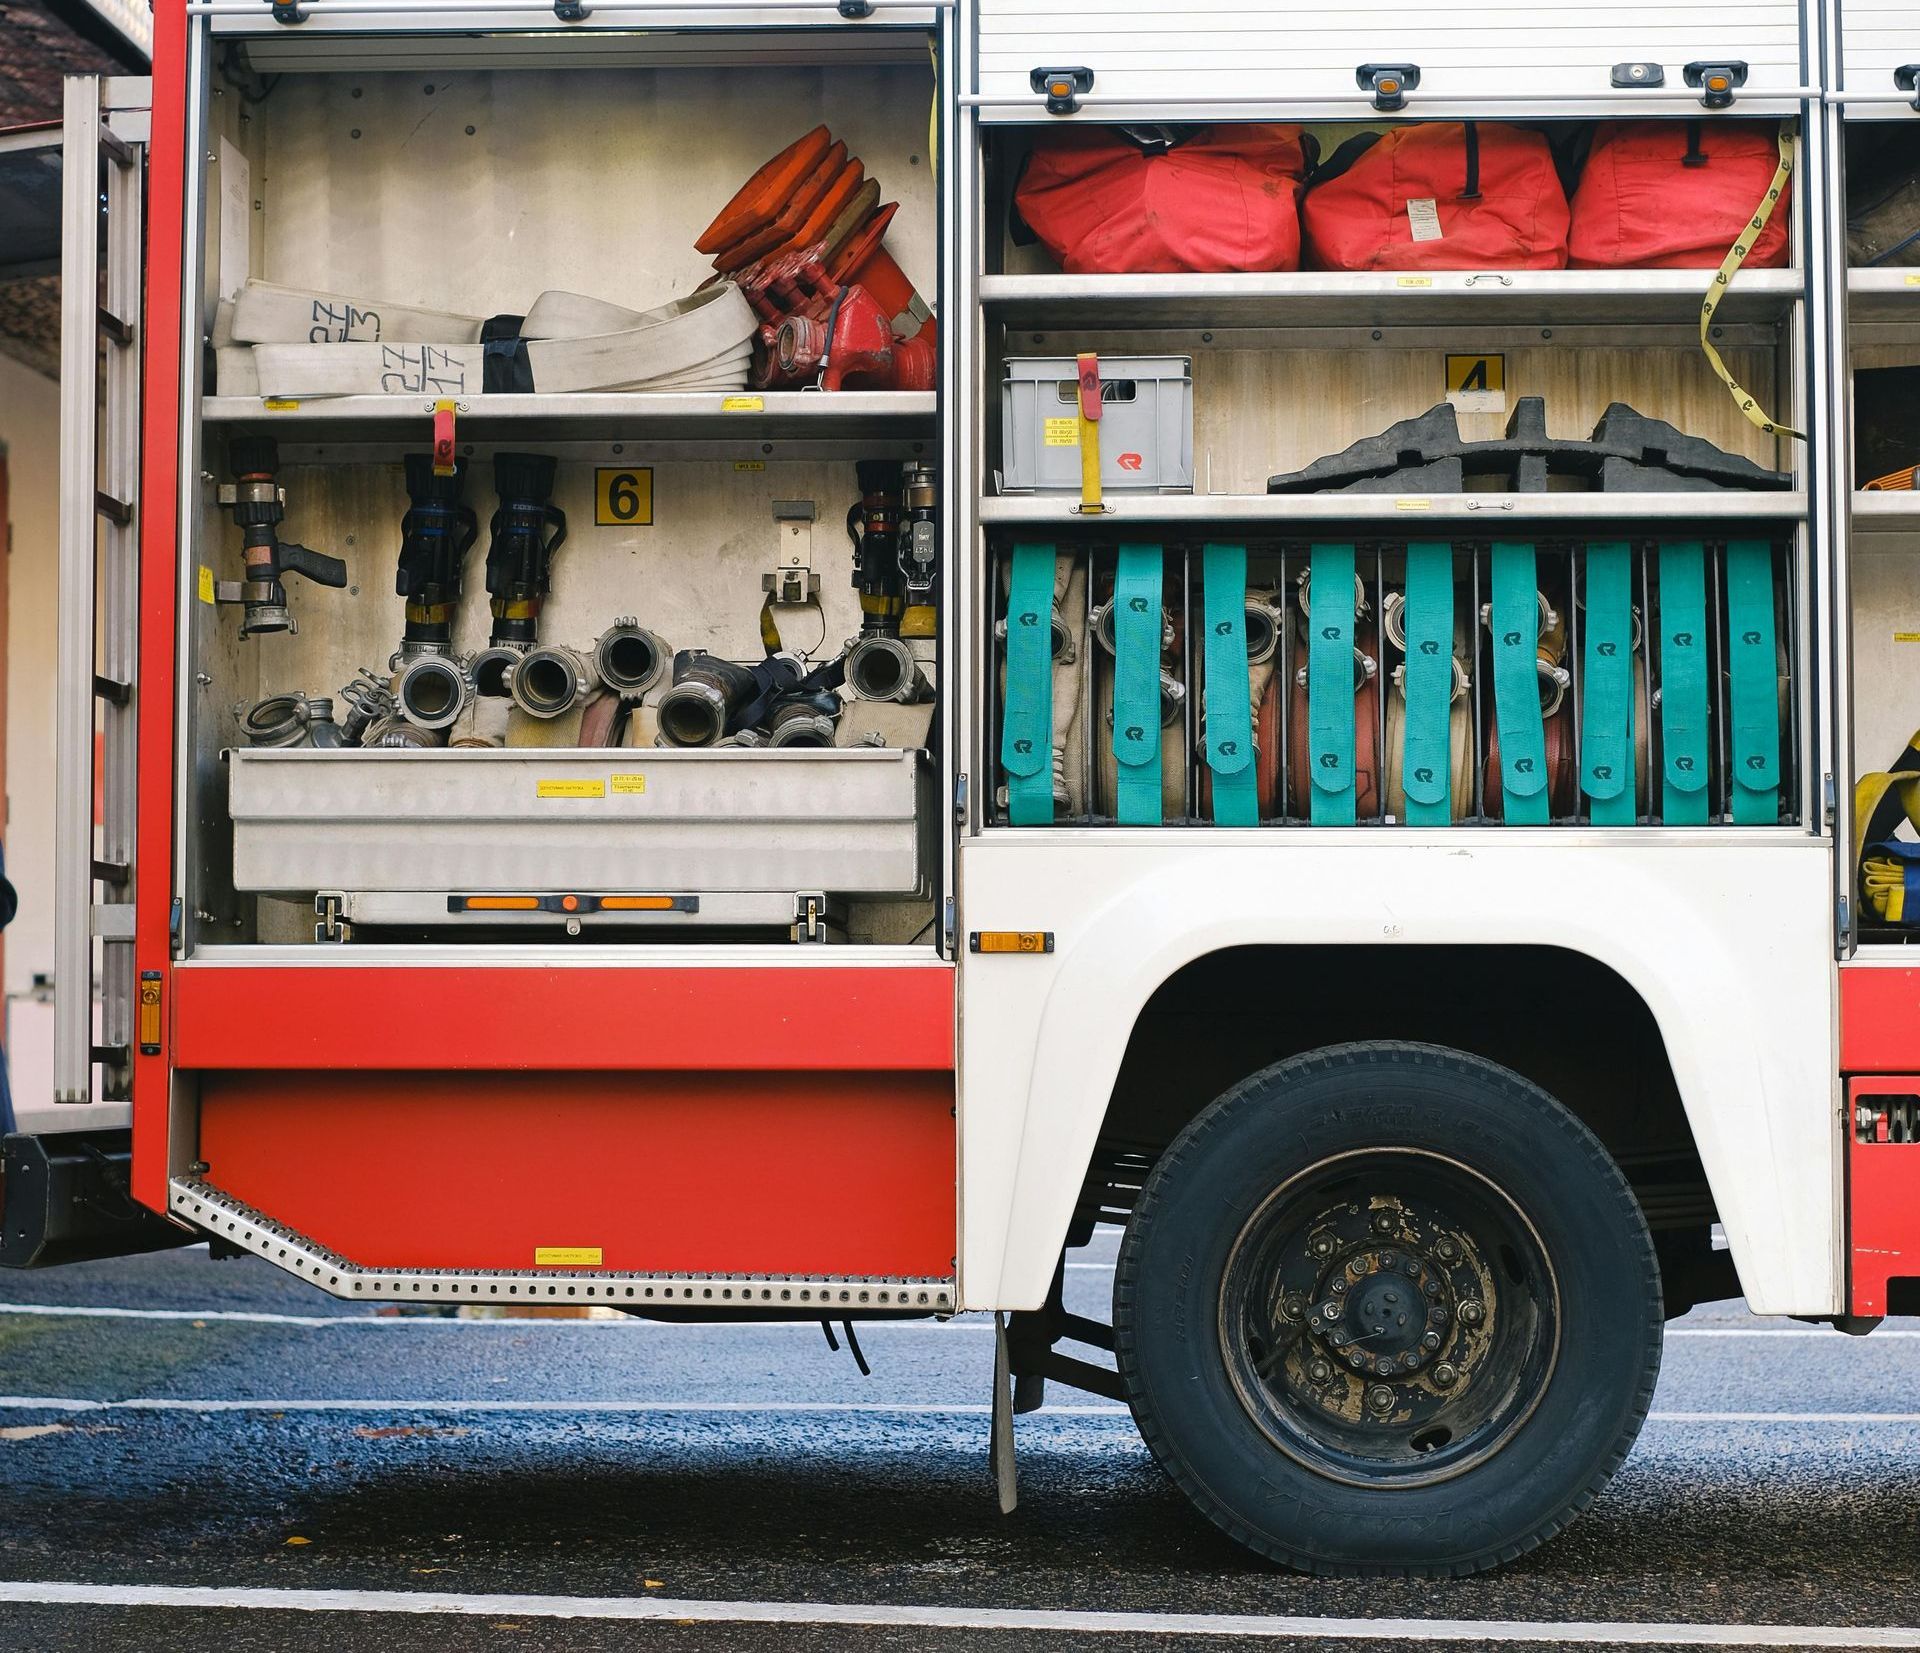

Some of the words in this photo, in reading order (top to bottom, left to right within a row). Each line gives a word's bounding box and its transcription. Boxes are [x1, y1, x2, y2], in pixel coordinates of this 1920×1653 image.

[309, 299, 345, 343] 27
[381, 344, 420, 392] 27
[427, 345, 465, 393] 17
[1459, 360, 1491, 391] 4
[608, 474, 640, 520] 6
